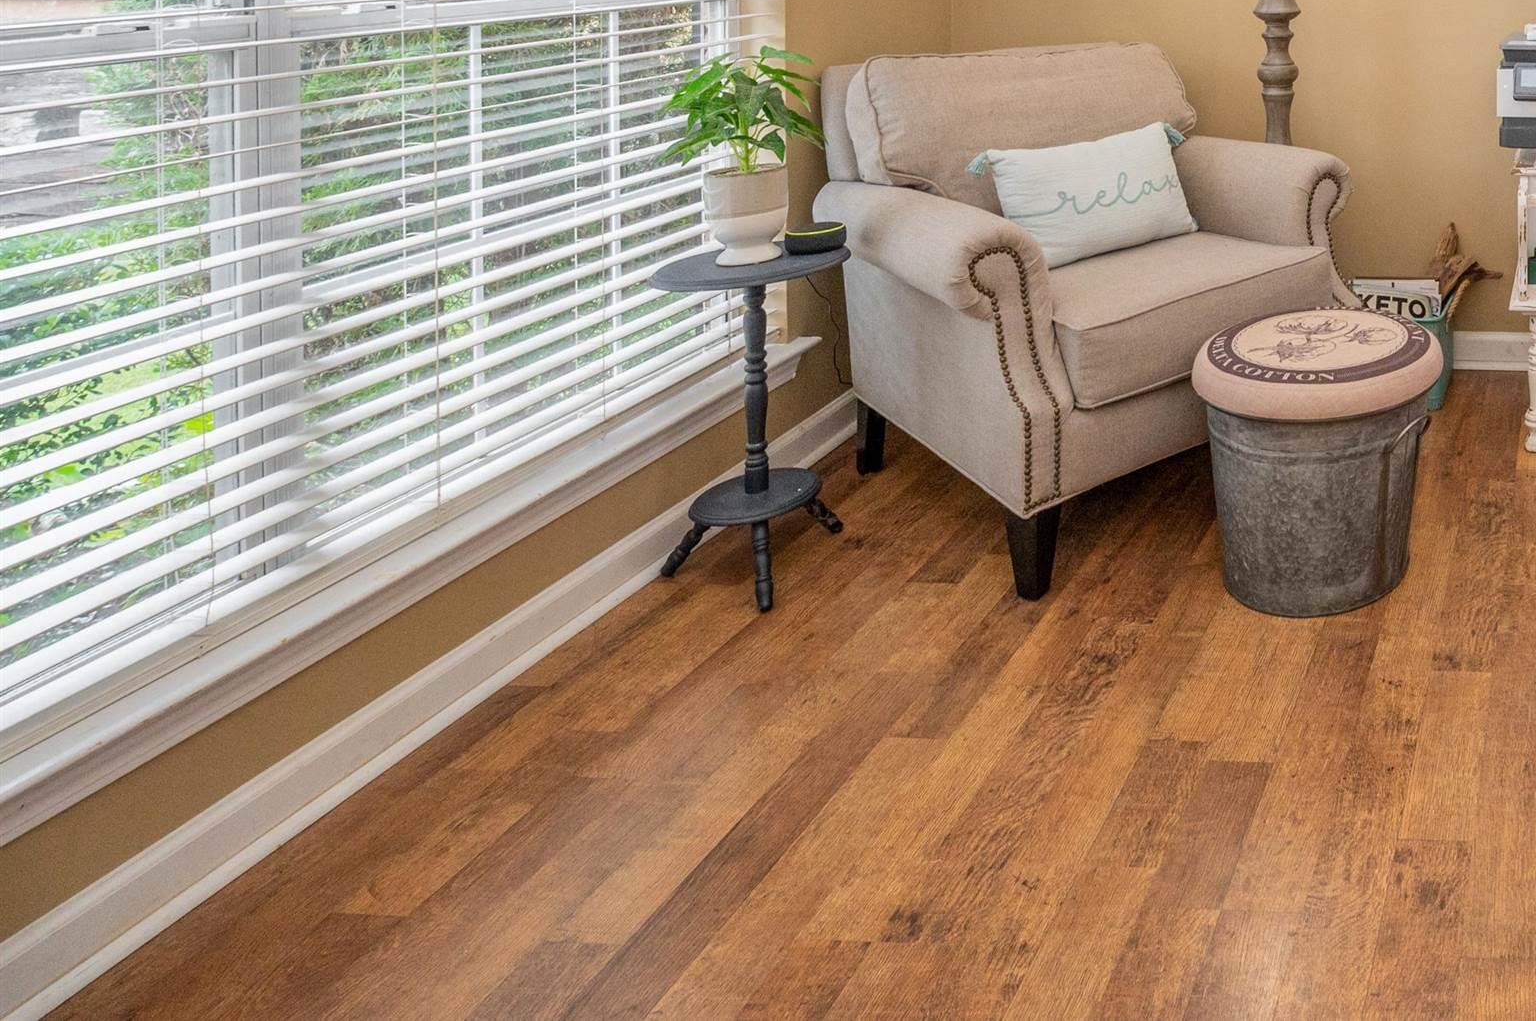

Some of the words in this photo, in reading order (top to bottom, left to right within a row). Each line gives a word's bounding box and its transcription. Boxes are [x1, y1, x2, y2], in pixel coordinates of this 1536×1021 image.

[1008, 171, 1180, 219] relax
[1357, 293, 1427, 319] KETO
[1212, 336, 1233, 367] DELTA
[1233, 363, 1335, 381] COTTON
